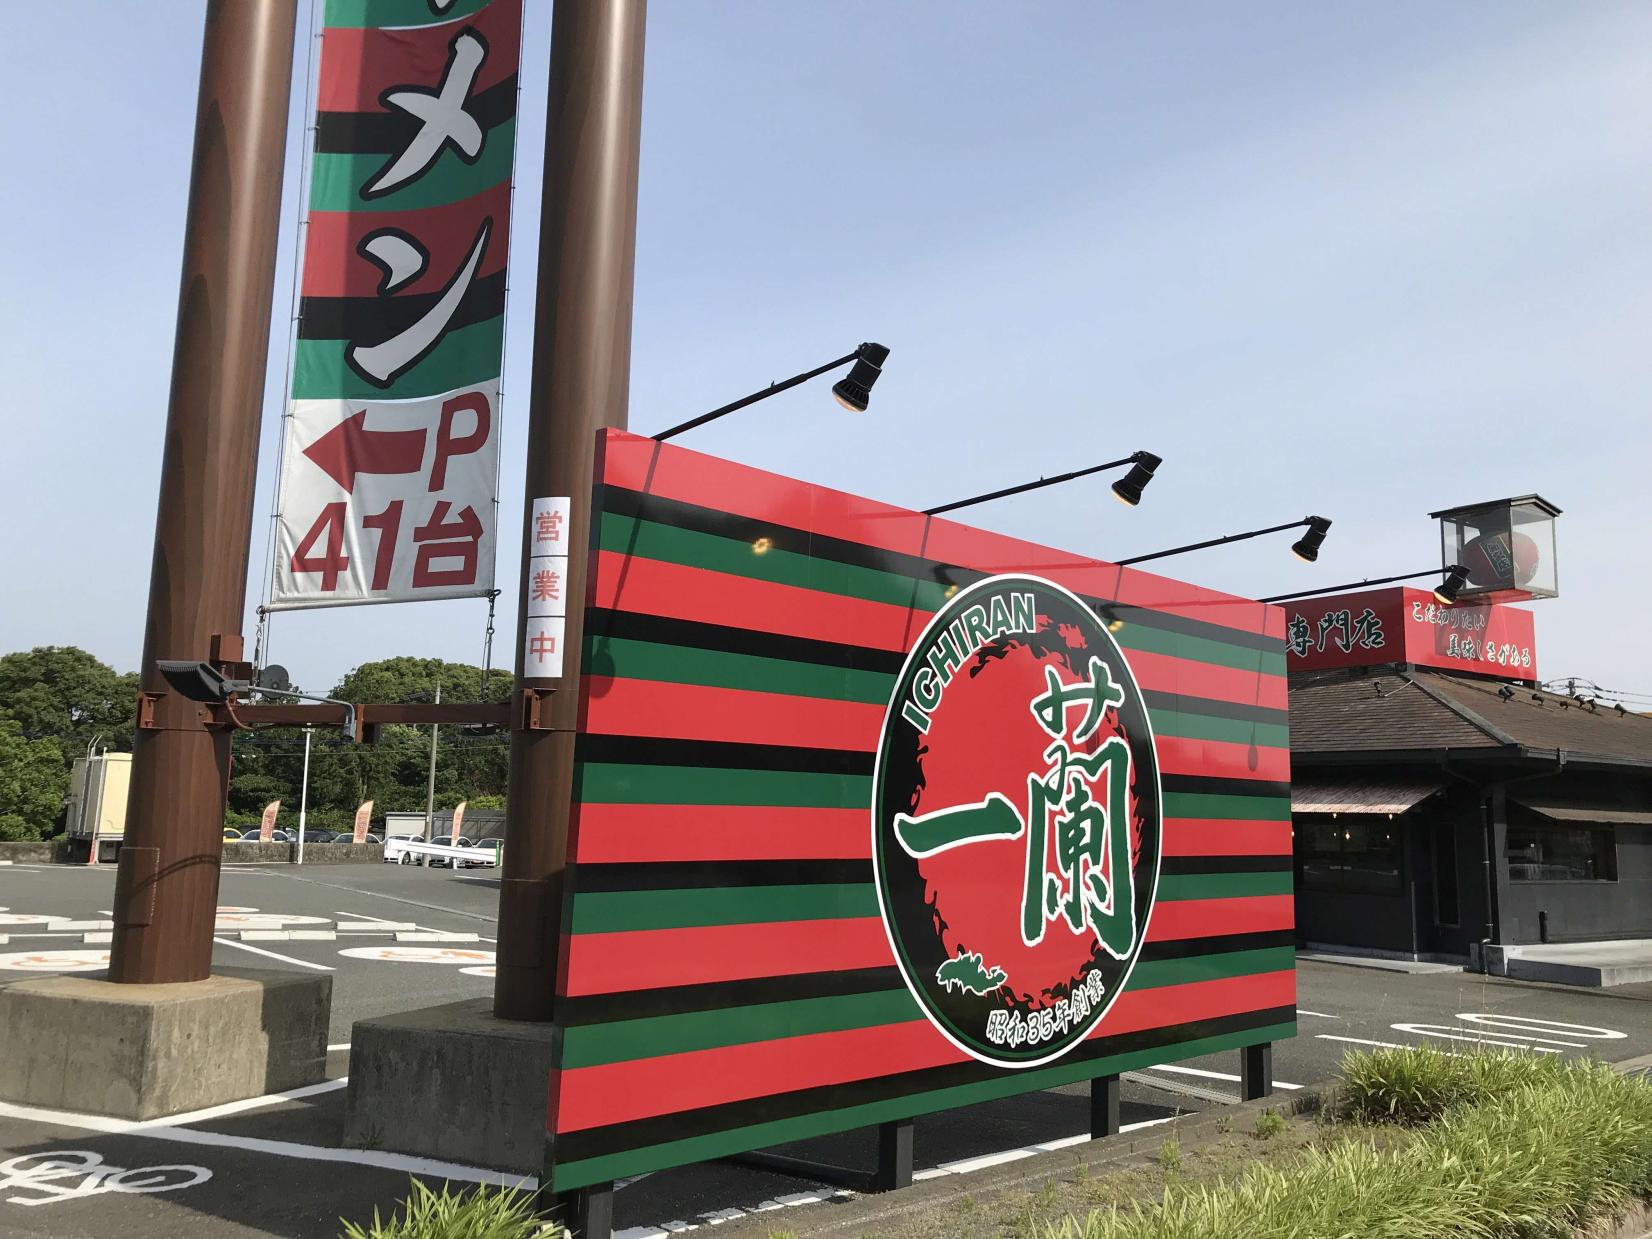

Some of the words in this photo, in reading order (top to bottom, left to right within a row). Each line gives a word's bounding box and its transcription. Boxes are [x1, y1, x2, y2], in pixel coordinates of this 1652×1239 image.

[344, 0, 493, 389] メン
[428, 391, 491, 492] P
[291, 500, 484, 591] 41台
[529, 510, 563, 663] 営業中
[903, 592, 1036, 735] ICHIRAN
[1447, 633, 1531, 667] 美味しさがある
[893, 656, 1136, 960] 一蘭
[986, 969, 1105, 1048] 昭和35年創業
